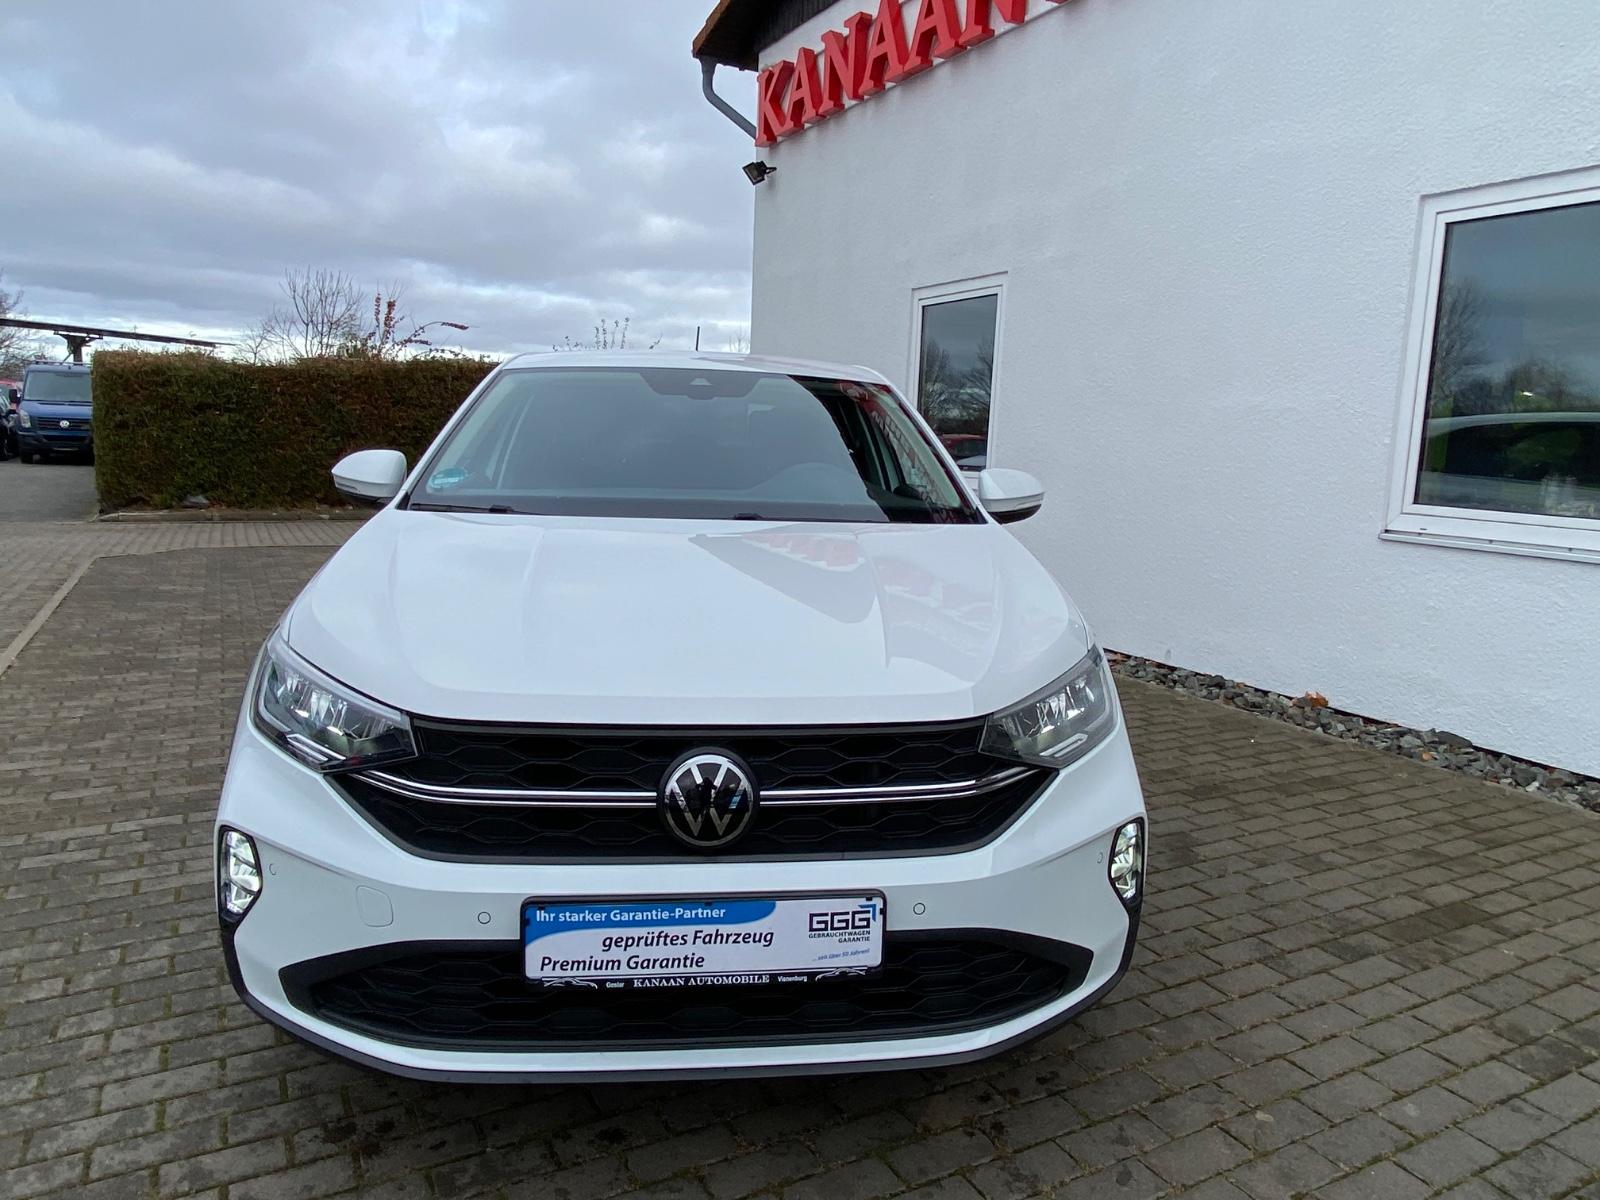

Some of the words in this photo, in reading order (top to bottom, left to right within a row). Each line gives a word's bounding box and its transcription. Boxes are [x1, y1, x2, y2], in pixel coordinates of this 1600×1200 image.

[665, 755, 752, 844] VW
[536, 909, 556, 922] Ihr
[559, 909, 607, 922] starker
[610, 907, 726, 921] Garantie-Partner
[808, 909, 871, 932] GGG
[602, 930, 688, 952] geprüftes
[692, 929, 774, 947] Fahrzeug
[808, 930, 871, 939] GEBRAUCHTWAGEN
[540, 956, 621, 972] Premium
[626, 953, 705, 970] Garantie
[633, 977, 685, 988] KANAAN
[688, 974, 770, 986] AUTOMOBILE
